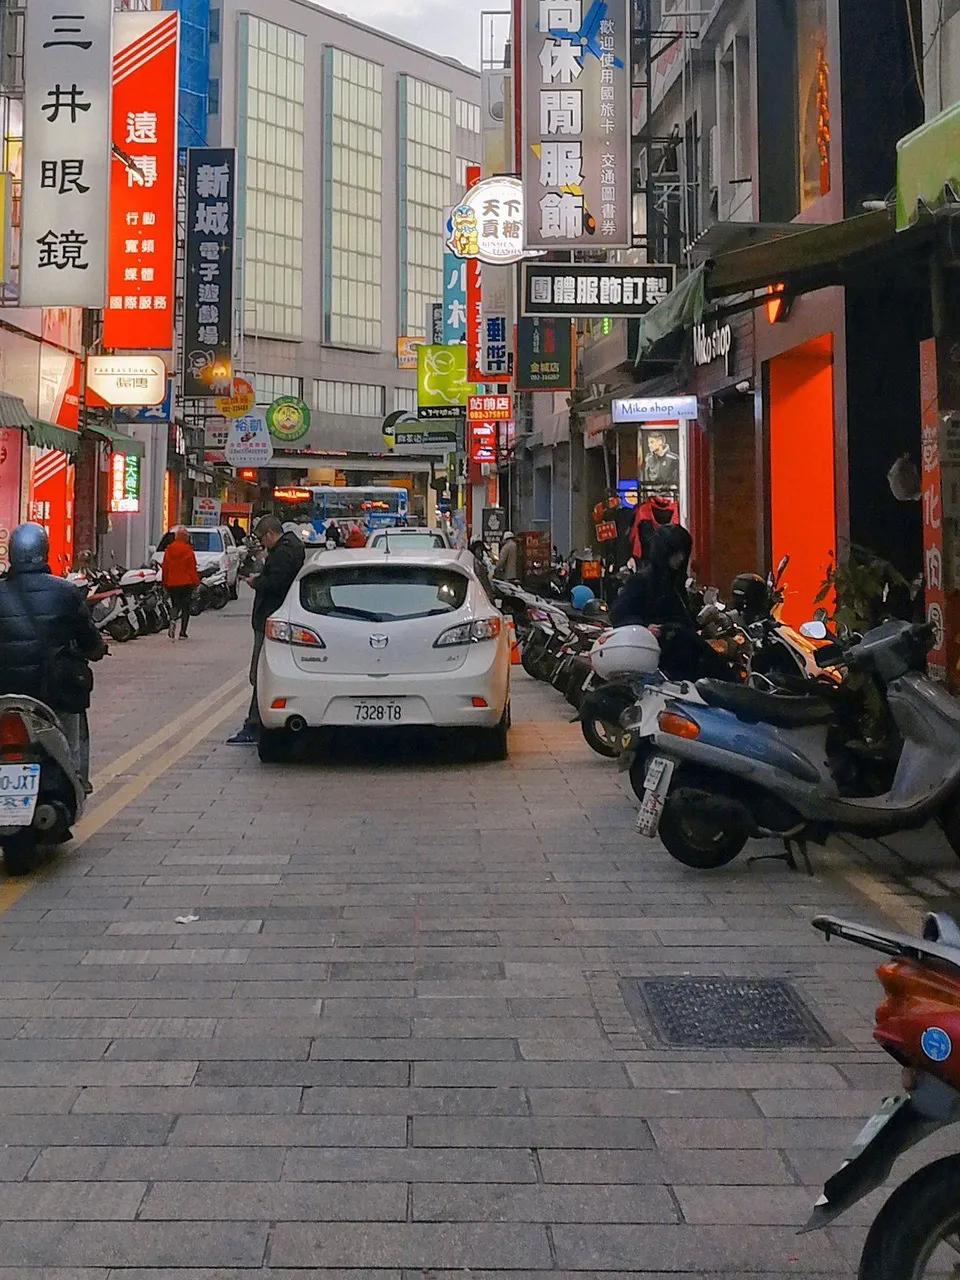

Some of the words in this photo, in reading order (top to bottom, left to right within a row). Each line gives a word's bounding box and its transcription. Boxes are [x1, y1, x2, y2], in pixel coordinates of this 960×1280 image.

[36, 15, 94, 271] 三井眼鏡
[482, 199, 521, 218] 天下
[125, 211, 156, 226] 行動
[531, 276, 668, 305] 團體服飾訂製
[469, 397, 509, 410] 站前店
[621, 403, 648, 415] Miko
[650, 402, 674, 416] shop
[354, 705, 402, 721] 7328-T8
